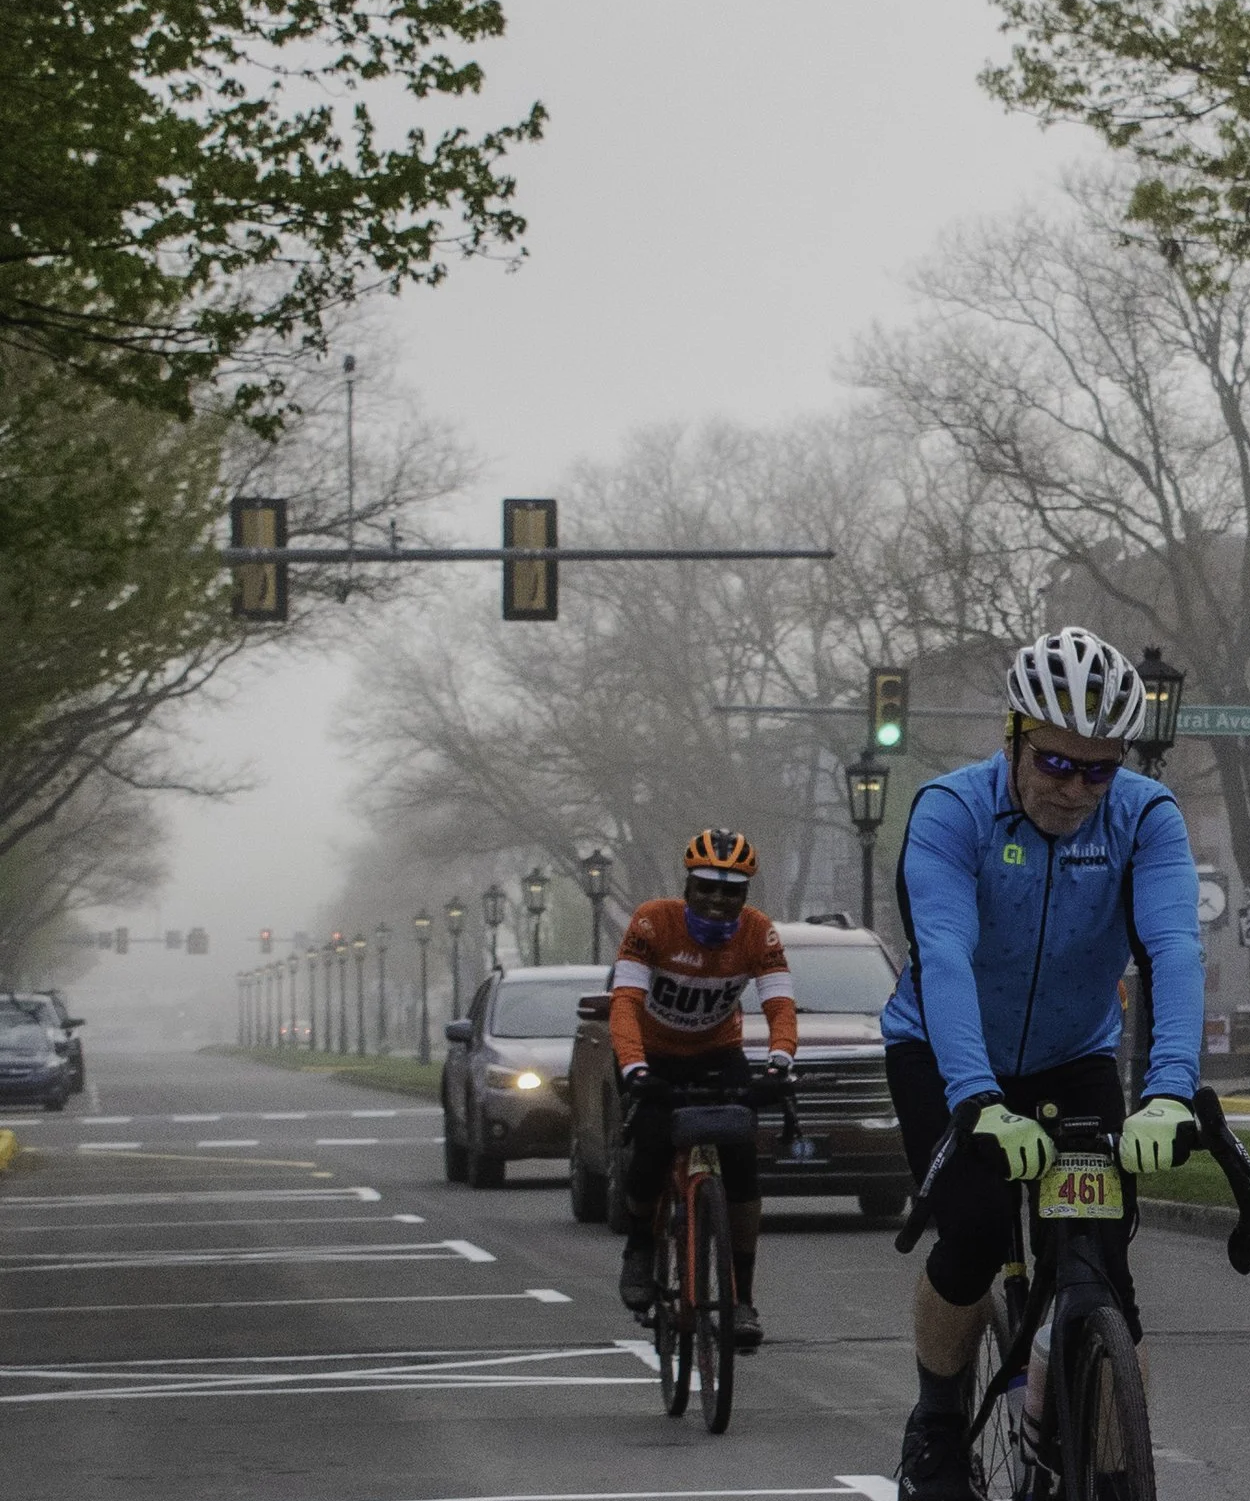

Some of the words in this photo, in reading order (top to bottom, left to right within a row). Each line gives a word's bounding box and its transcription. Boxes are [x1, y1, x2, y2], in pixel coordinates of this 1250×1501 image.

[1177, 712, 1209, 729] tral
[652, 975, 741, 1013] GUY'S
[1058, 1172, 1105, 1205] 461
